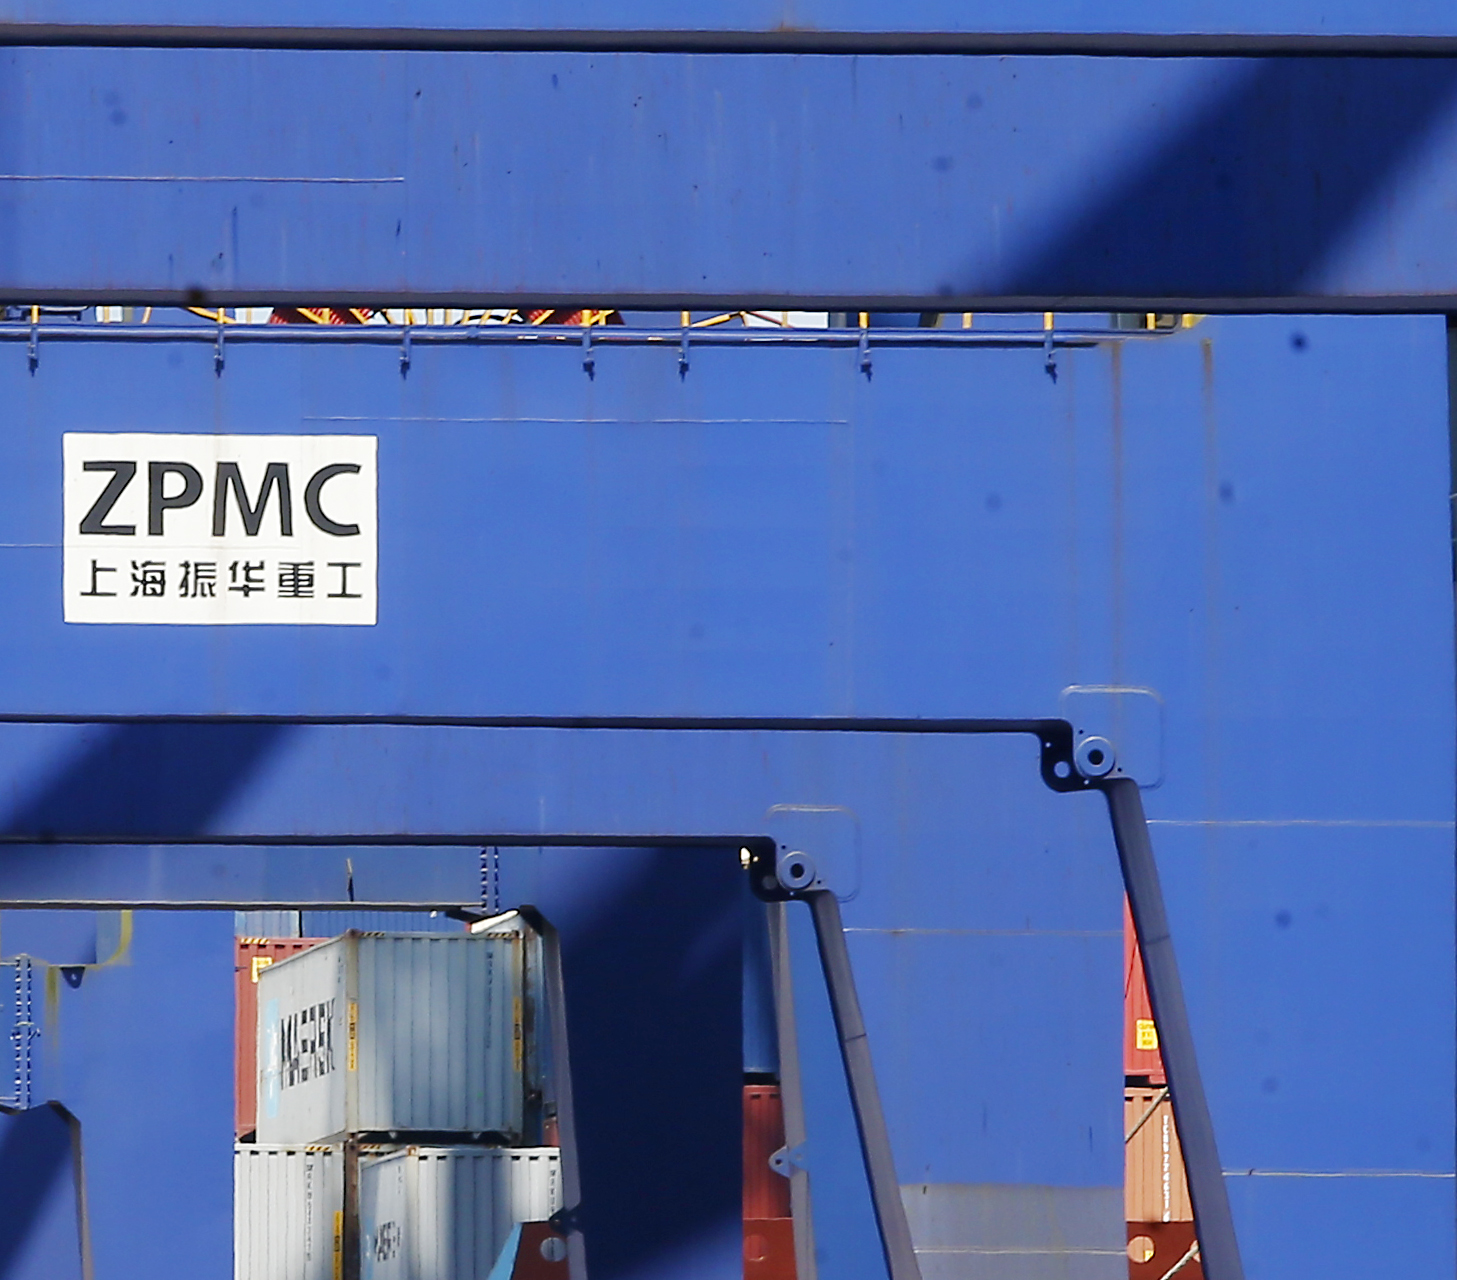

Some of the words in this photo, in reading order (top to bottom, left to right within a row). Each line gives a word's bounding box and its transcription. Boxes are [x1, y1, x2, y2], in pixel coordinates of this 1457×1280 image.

[79, 461, 362, 536] ZPMC
[79, 559, 363, 598] 上海振华重工
